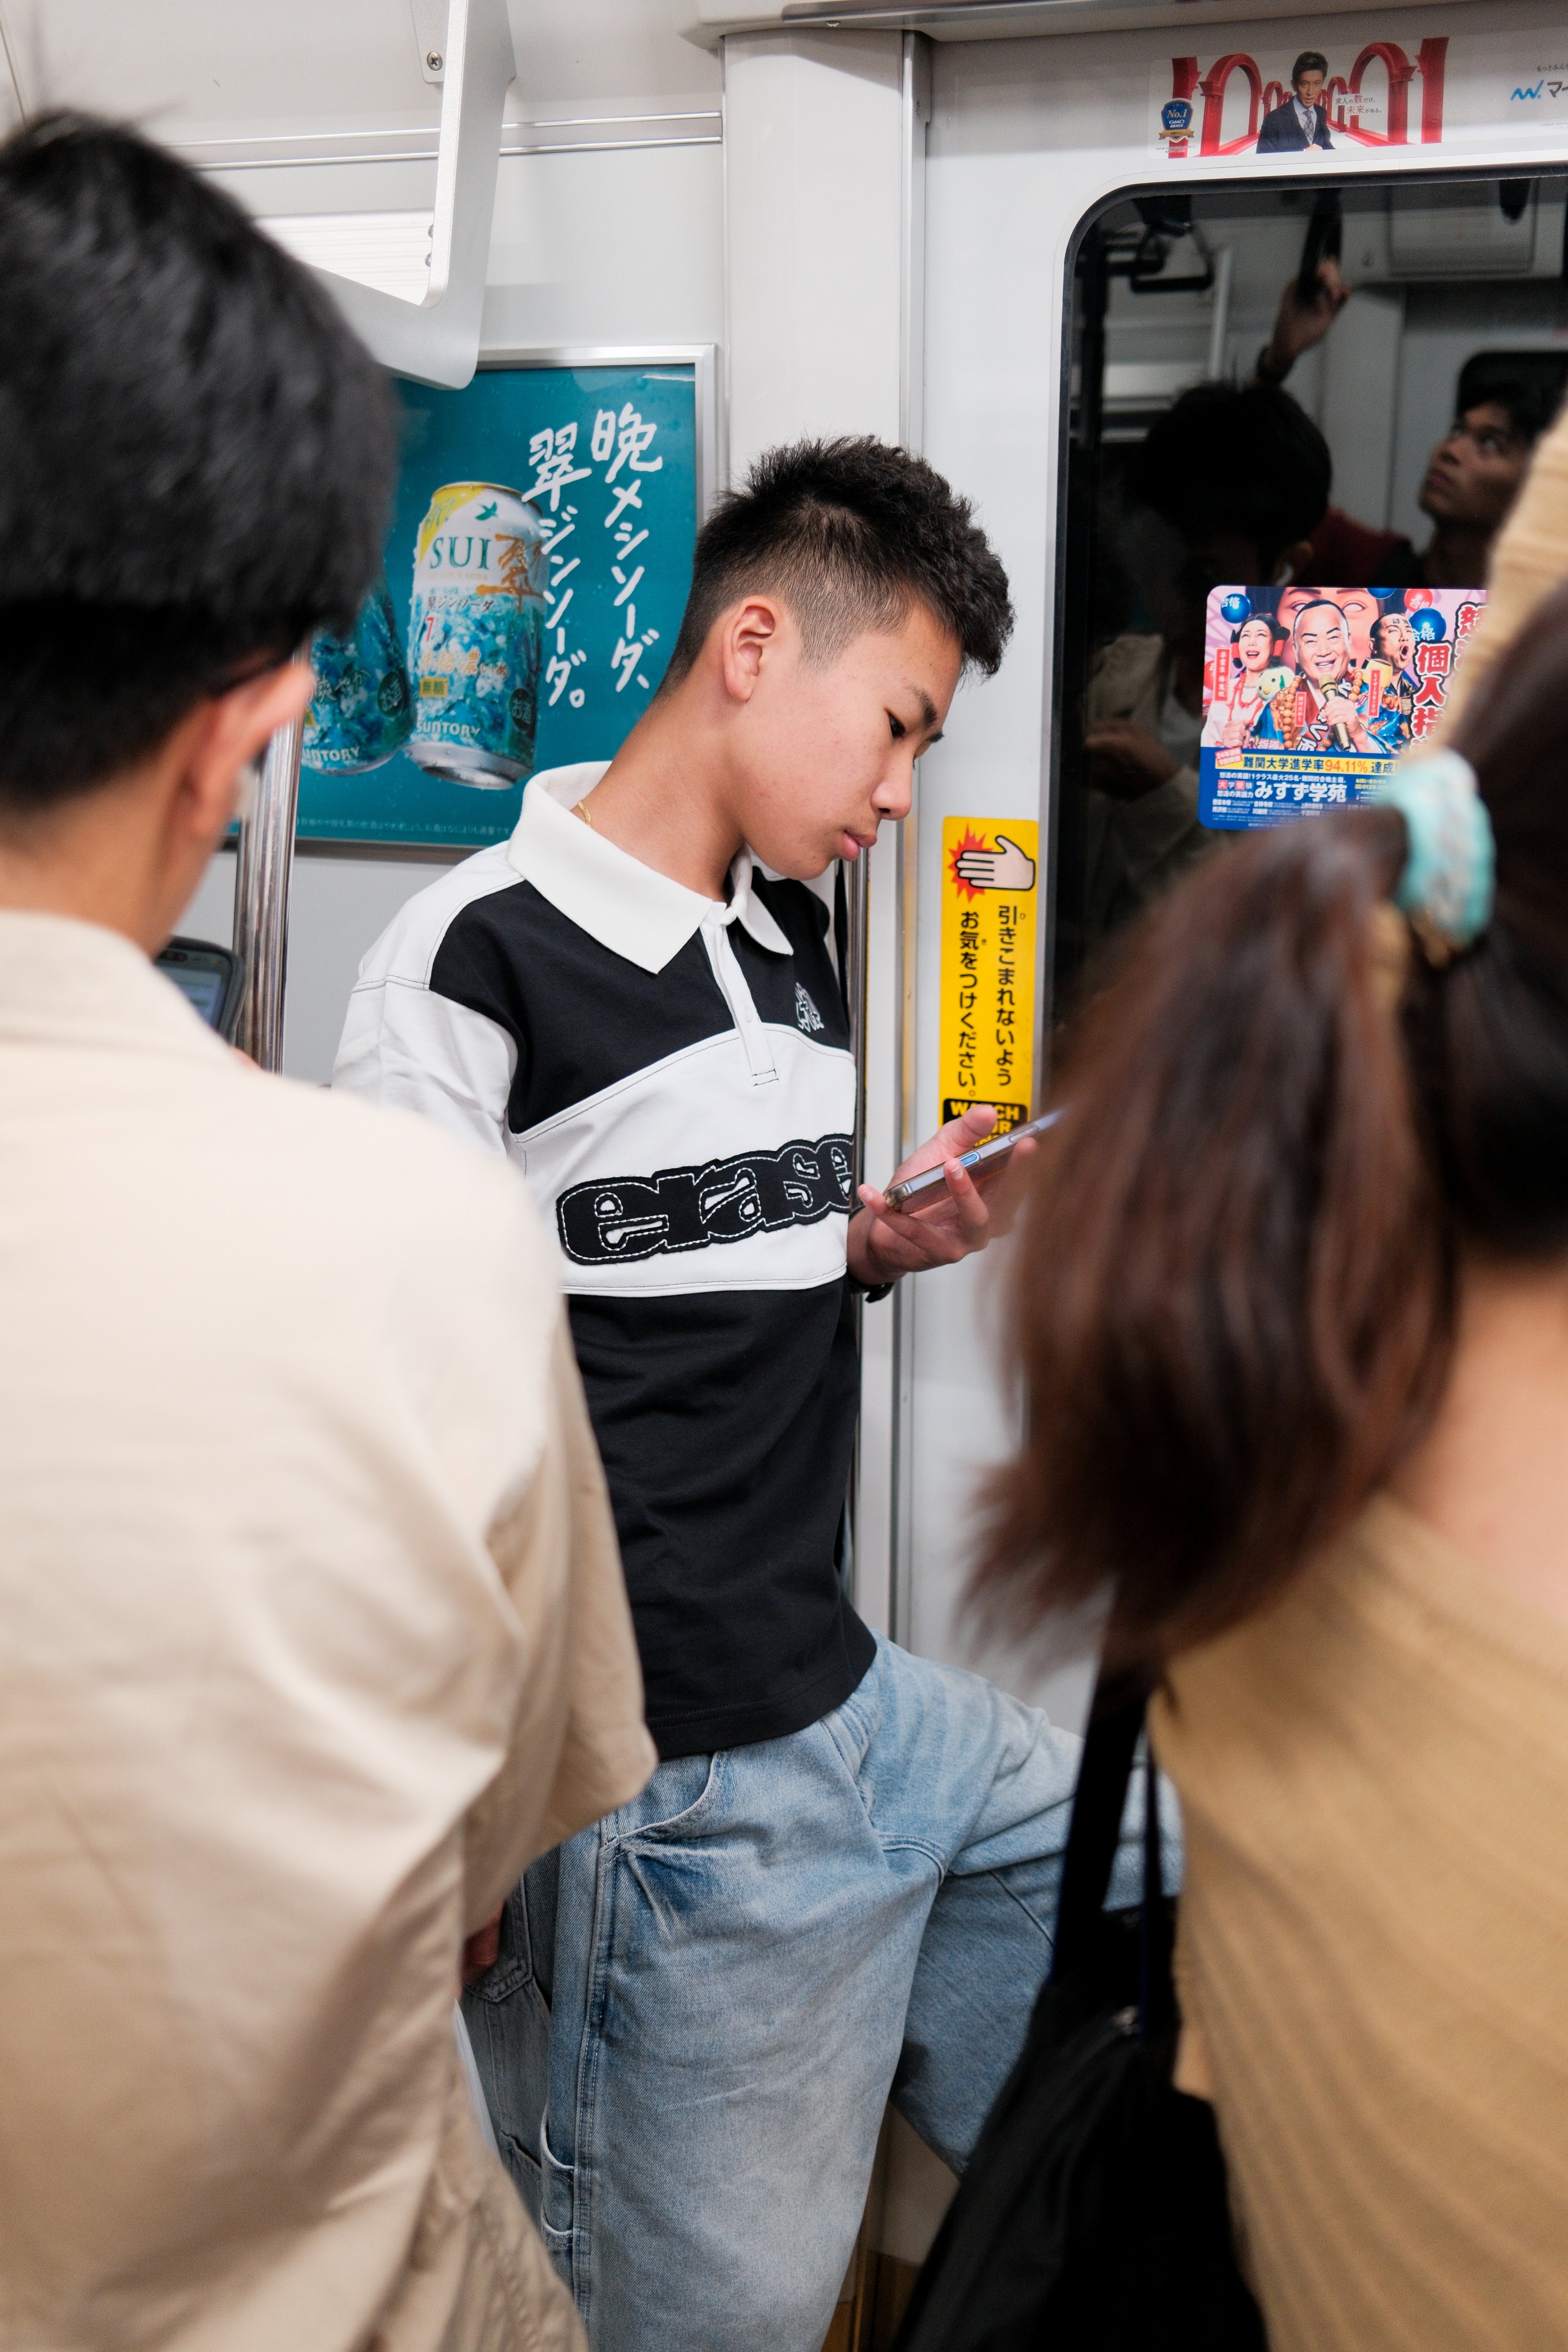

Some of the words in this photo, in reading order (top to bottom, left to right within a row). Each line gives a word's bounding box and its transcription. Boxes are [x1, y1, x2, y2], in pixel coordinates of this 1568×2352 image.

[1335, 95, 1375, 105] 求人の数だけ、
[1167, 108, 1188, 118] No.1
[1346, 105, 1382, 114] 未来がある。
[430, 537, 492, 570] SUI
[1222, 596, 1240, 609] 合格
[416, 721, 480, 737] SUNTORY
[302, 747, 360, 762] UNTORY
[1255, 781, 1348, 803] みすず学苑
[959, 911, 979, 1097] お気をつけください。
[997, 906, 1017, 1086] 引きこまれないよう
[950, 1101, 1020, 1121] WCH
